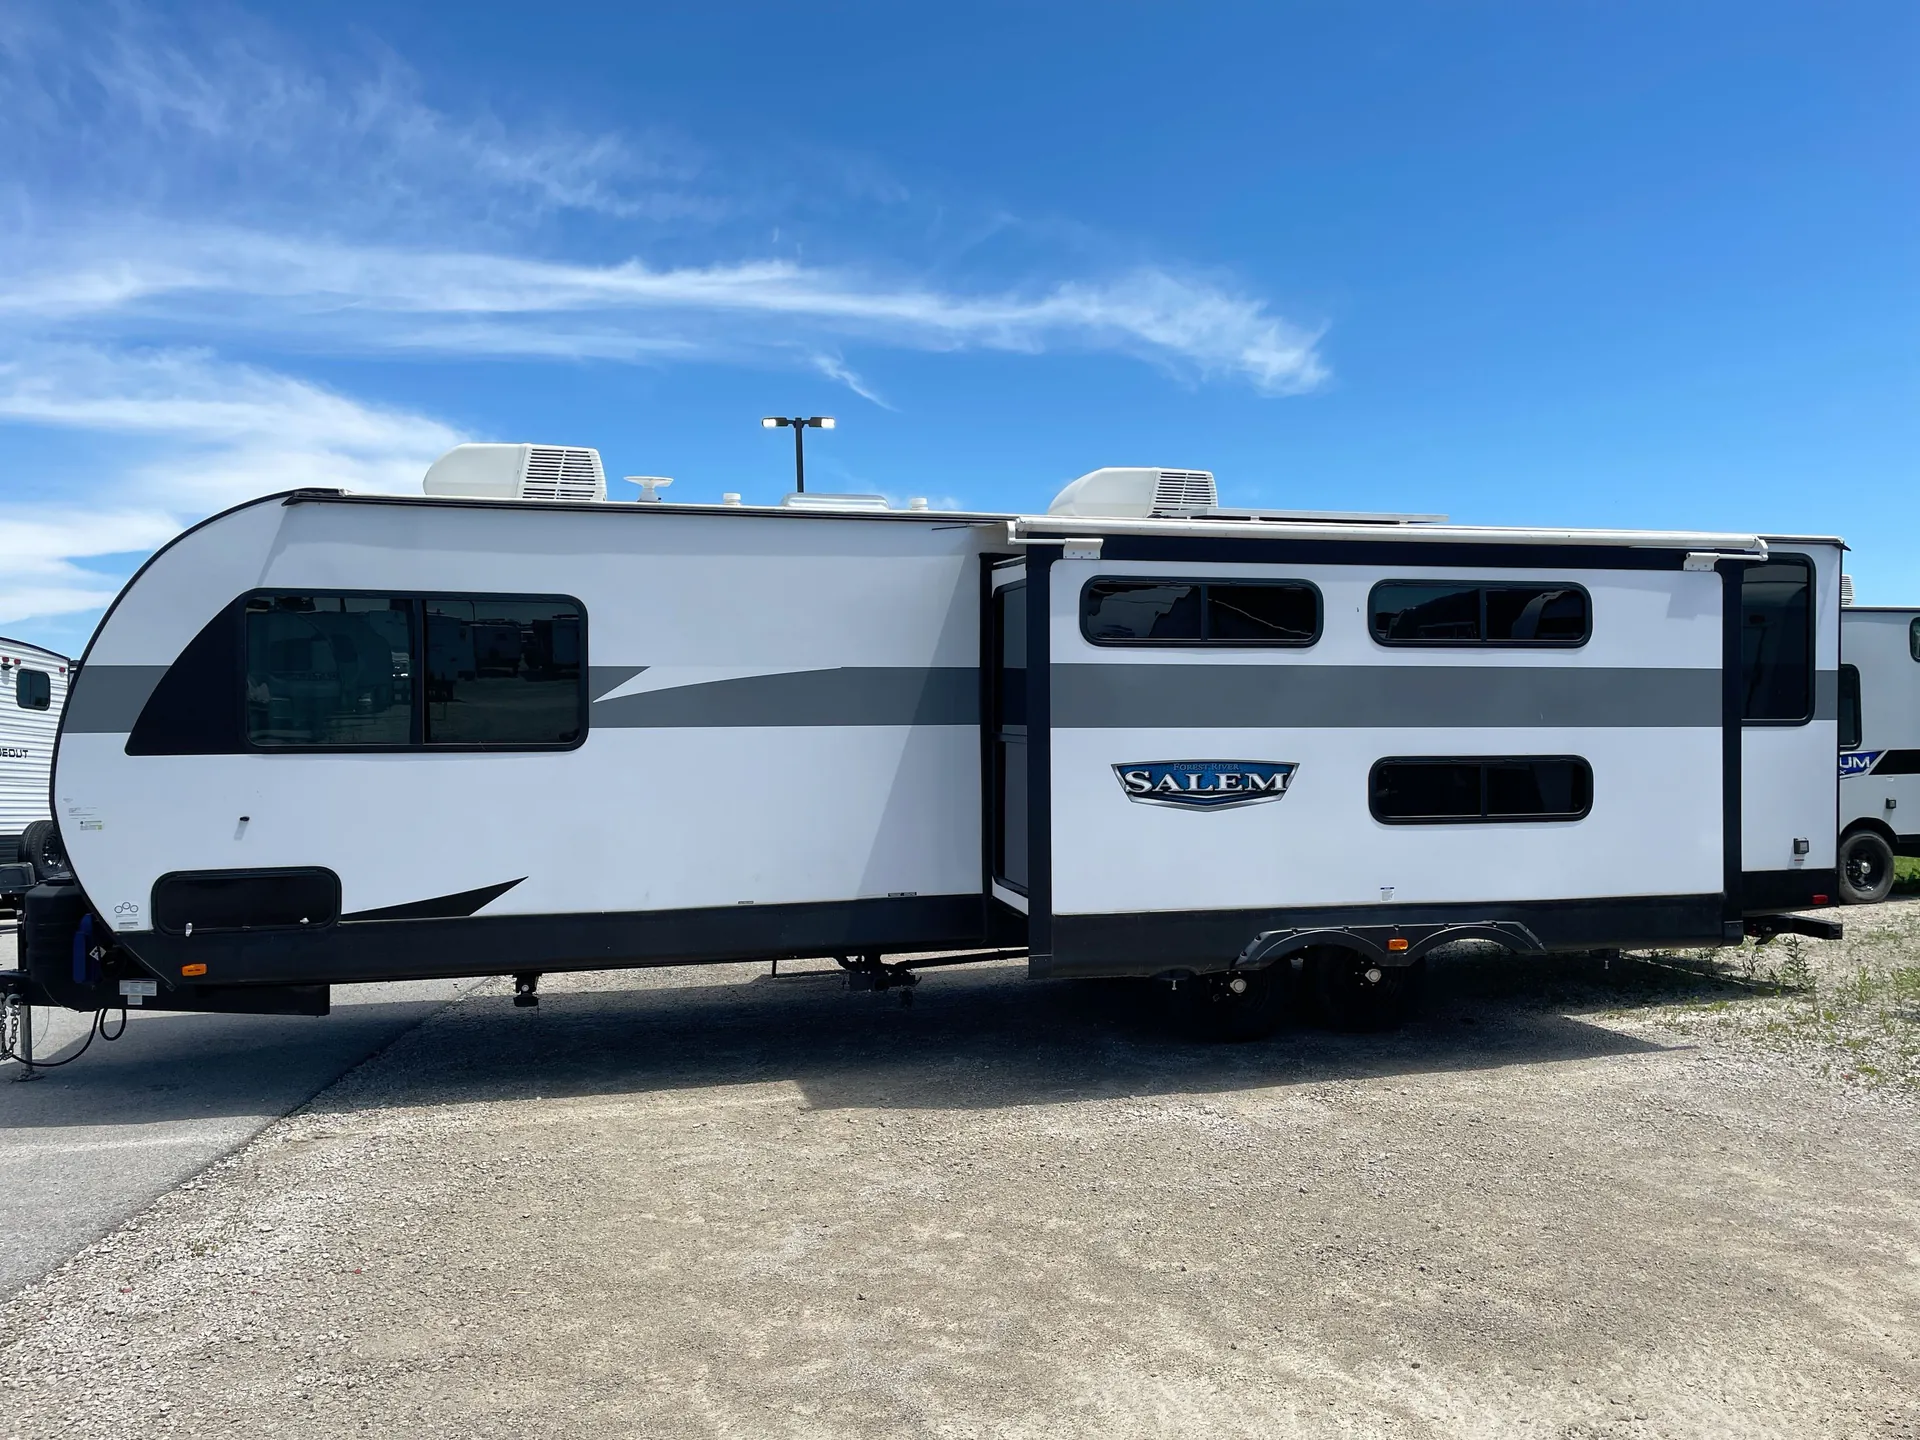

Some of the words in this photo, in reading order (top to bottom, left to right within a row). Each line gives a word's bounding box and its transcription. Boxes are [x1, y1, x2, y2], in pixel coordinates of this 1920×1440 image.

[0, 748, 29, 758] EOUT
[1173, 763, 1209, 771] FOREST
[1211, 763, 1240, 771] RIVER
[1125, 770, 1288, 793] SALEM
